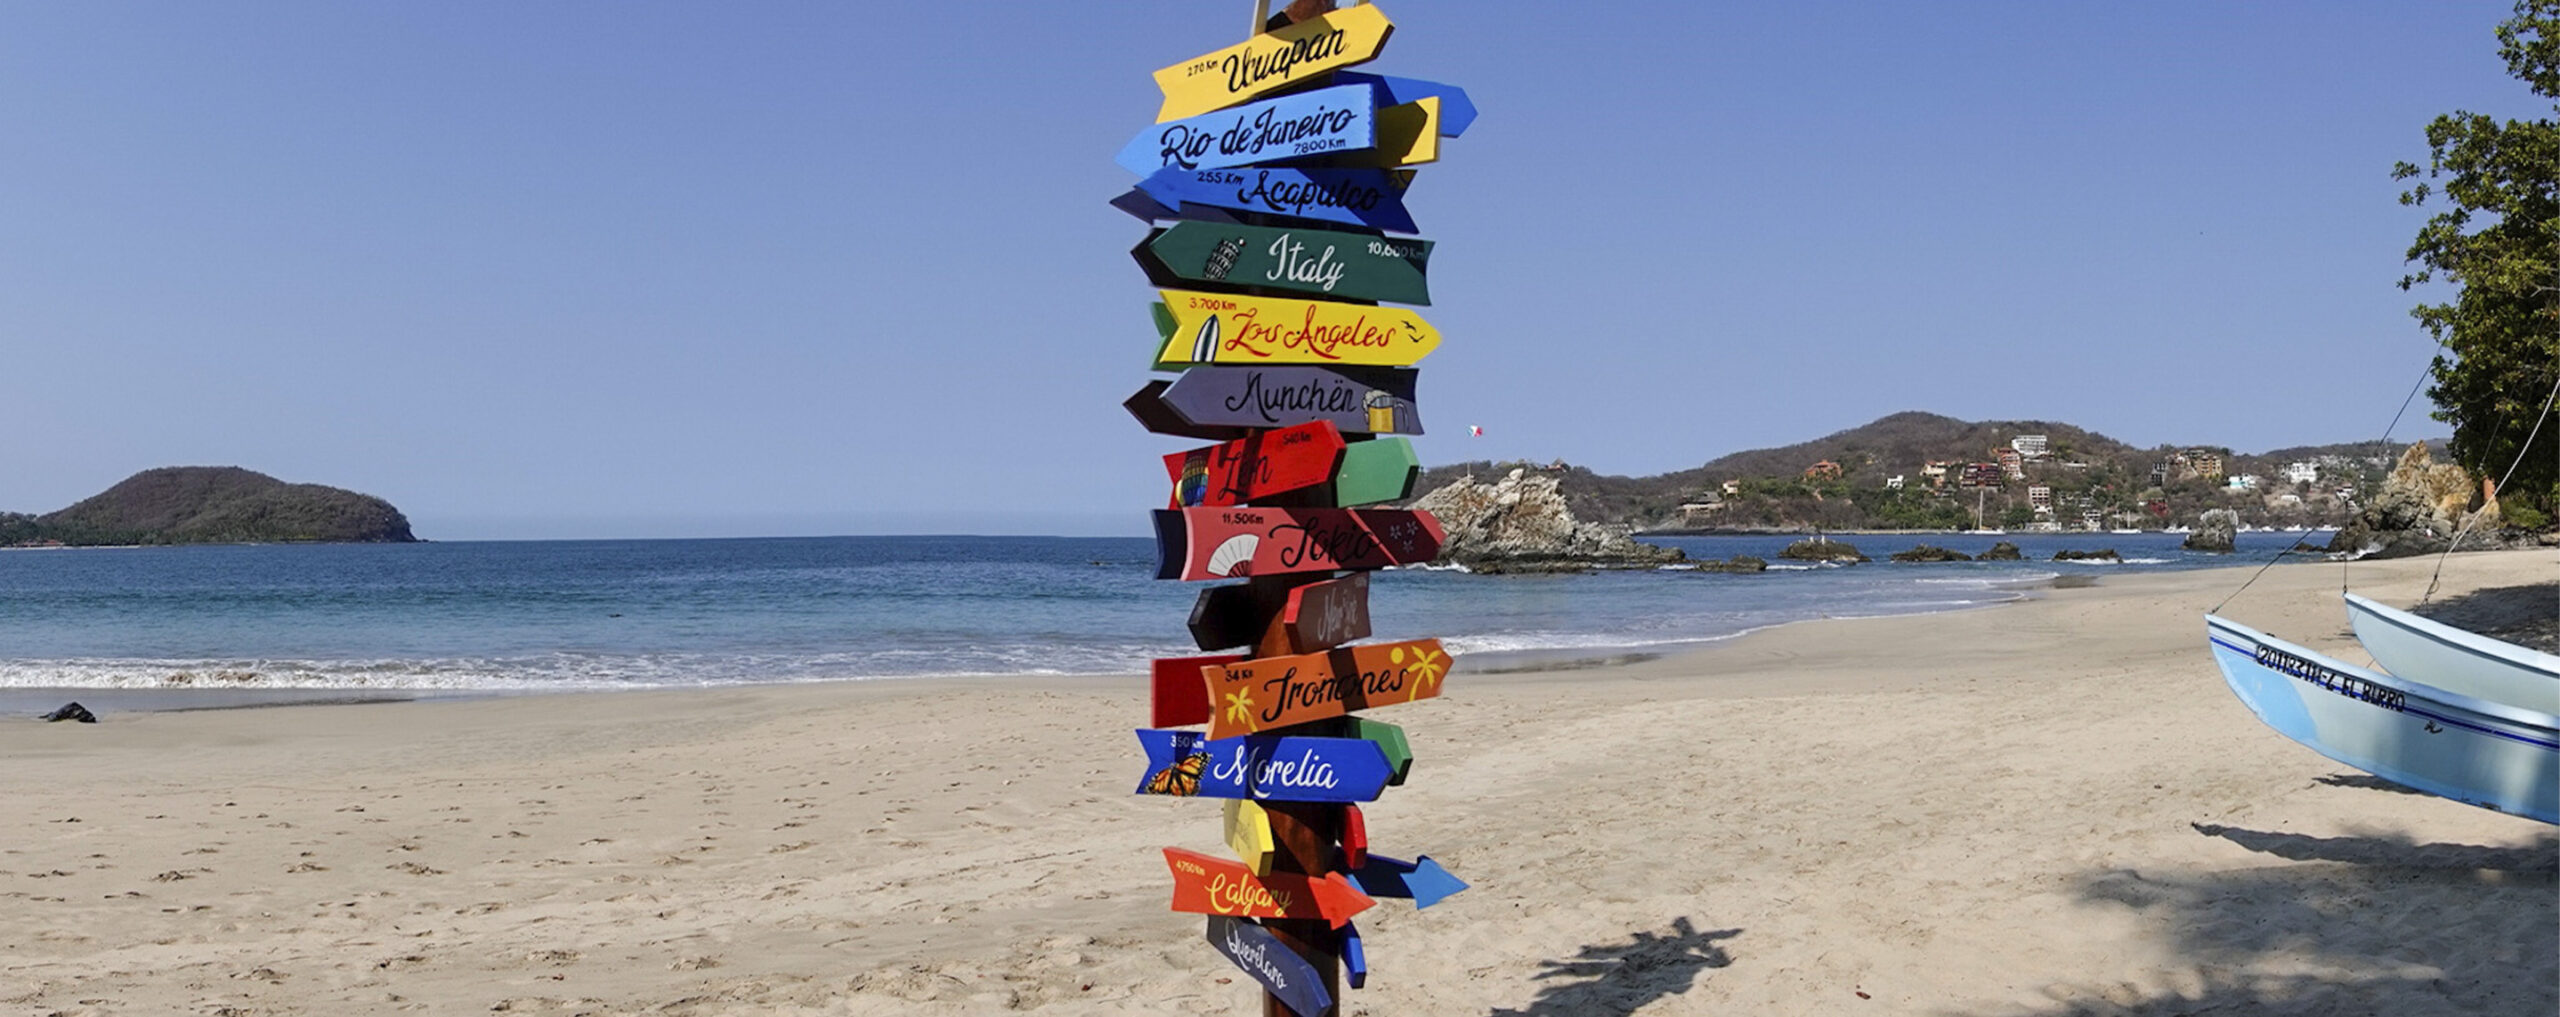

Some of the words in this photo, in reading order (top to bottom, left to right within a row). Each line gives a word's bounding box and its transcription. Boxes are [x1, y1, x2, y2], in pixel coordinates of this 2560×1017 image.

[1187, 63, 1204, 77] 270
[1206, 59, 1218, 72] Km
[1160, 124, 1216, 170] Rio
[1219, 115, 1252, 156] de
[1250, 105, 1357, 155] Janeiro
[1294, 141, 1327, 154] 7800
[1329, 138, 1346, 149] Km
[1197, 171, 1222, 184] 255
[1224, 173, 1244, 186] Km
[1237, 170, 1385, 215] Acapulco
[1266, 233, 1344, 292] Italy
[1222, 301, 1237, 311] Km
[1225, 308, 1283, 357] Los
[1283, 304, 1396, 359] Angeles
[1268, 516, 1382, 568] Tokio
[1170, 735, 1191, 748] 350
[1213, 744, 1339, 798] Morelia
[1204, 873, 1293, 917] Calgary
